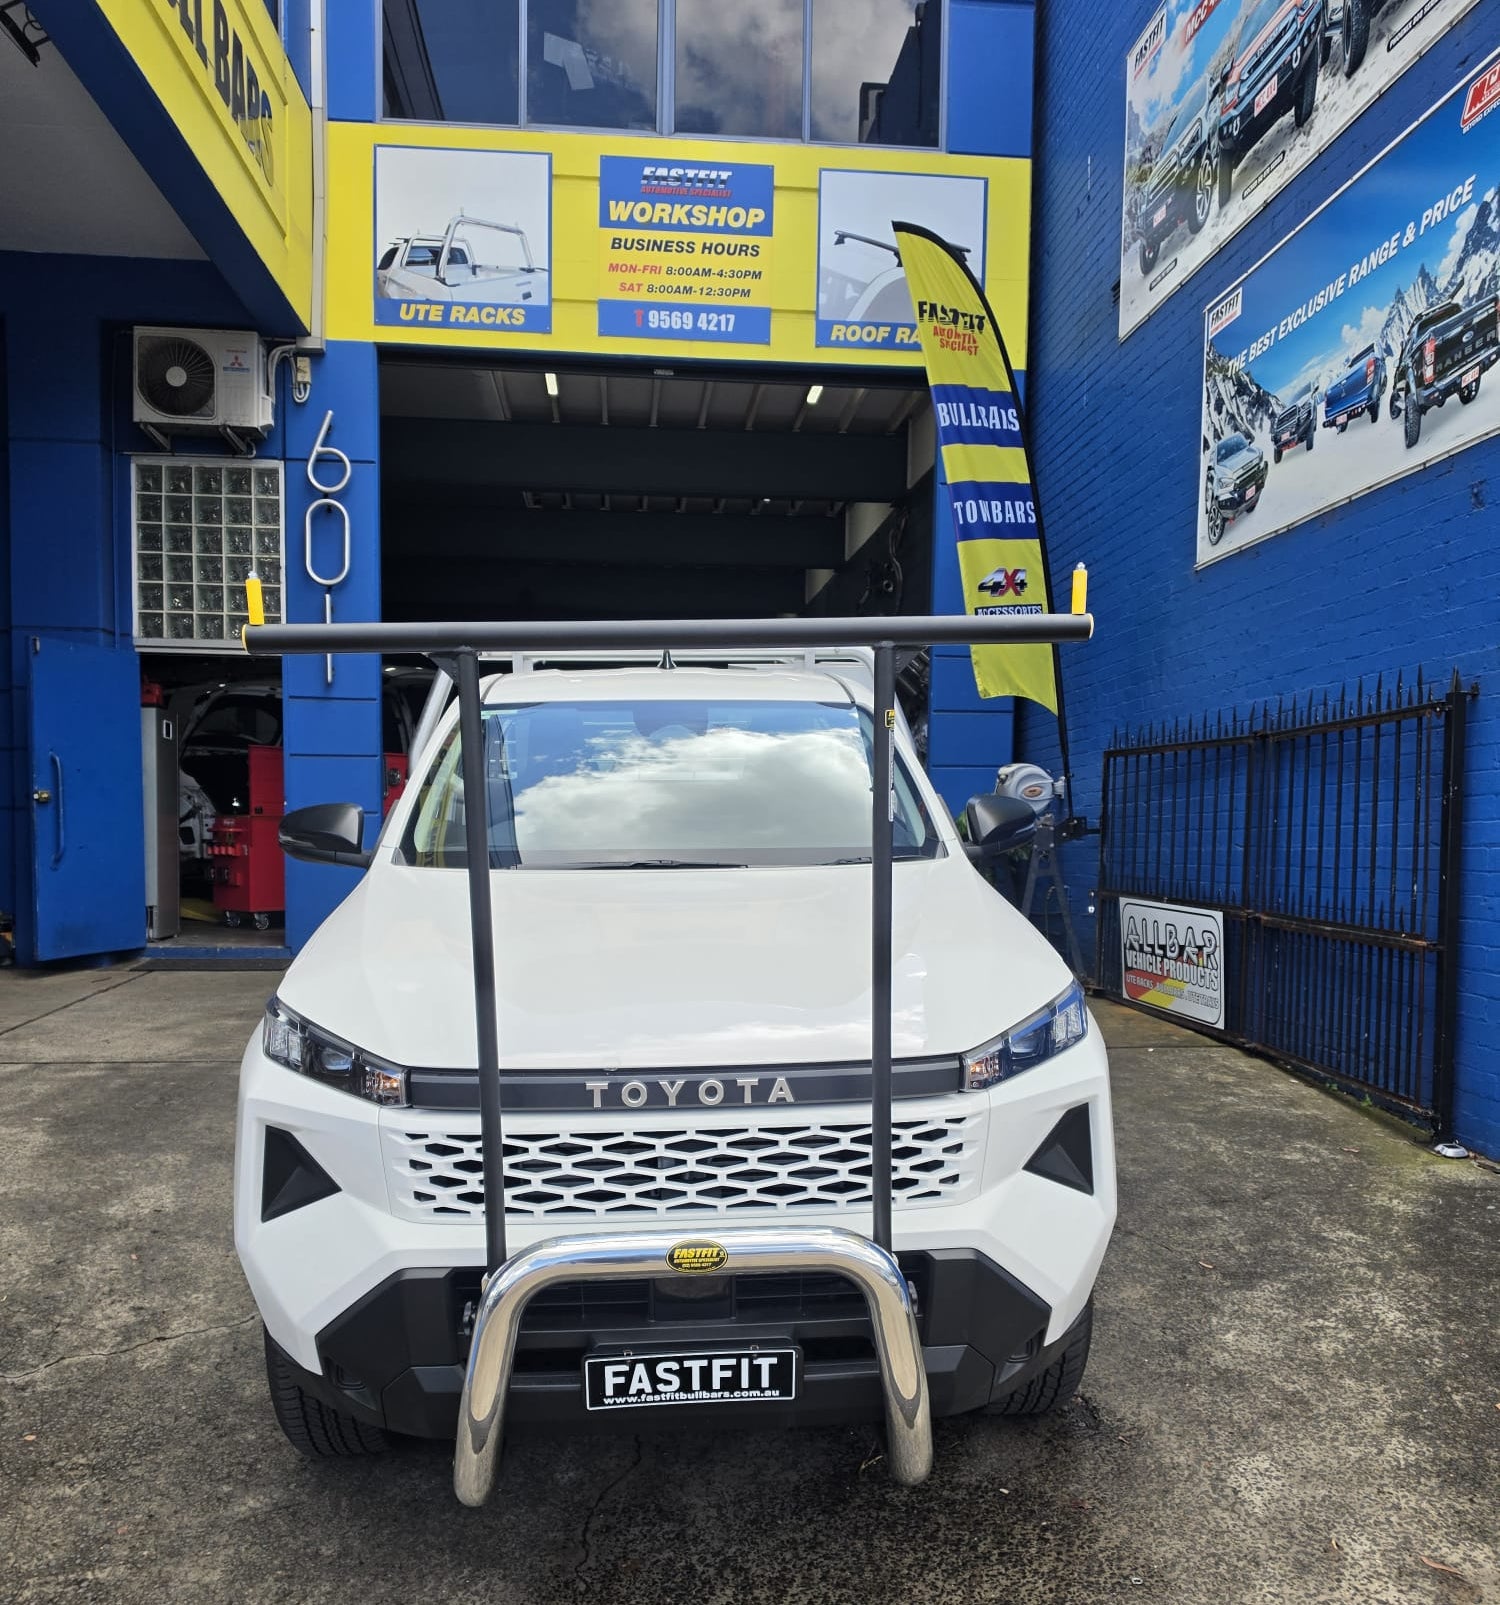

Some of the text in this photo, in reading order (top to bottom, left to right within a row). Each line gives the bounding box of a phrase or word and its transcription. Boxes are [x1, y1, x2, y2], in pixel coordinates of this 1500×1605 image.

[1134, 12, 1165, 71] FASTFIT
[641, 166, 733, 189] FASTFIT
[641, 185, 732, 198] AUTOMOTIVE SPECIALIST
[608, 200, 765, 229] WORKSHOP
[611, 237, 761, 258] BUSINESS HOURS
[608, 263, 763, 280] MON-FRI 8:00AM-4:30PM
[1227, 348, 1248, 377] THE
[1249, 326, 1278, 362] BEST
[1278, 273, 1347, 340] EXCLUSIVE
[1348, 231, 1401, 288] RANGE
[1402, 221, 1416, 248] &
[1419, 174, 1477, 236] PRICE
[619, 282, 752, 298] SAT 8:00AM-12:30PM
[400, 303, 526, 325] UTE RACKS
[633, 308, 736, 332] T 9569 4217
[918, 301, 986, 335] FASTFIT
[1211, 291, 1240, 329] FASTFIT
[830, 324, 921, 344] ROOF RA
[954, 500, 1037, 525] TOWBARS
[306, 409, 351, 684] 601
[1125, 915, 1219, 970] ALLBAR
[1126, 949, 1219, 992] VEHICLE PRODUCTS
[585, 1076, 795, 1108] TOYOTA
[673, 1247, 720, 1259] FASTFIT
[604, 1357, 778, 1397] FASTFIT
[603, 1388, 780, 1405] www.fastfitbullbars.com.au
